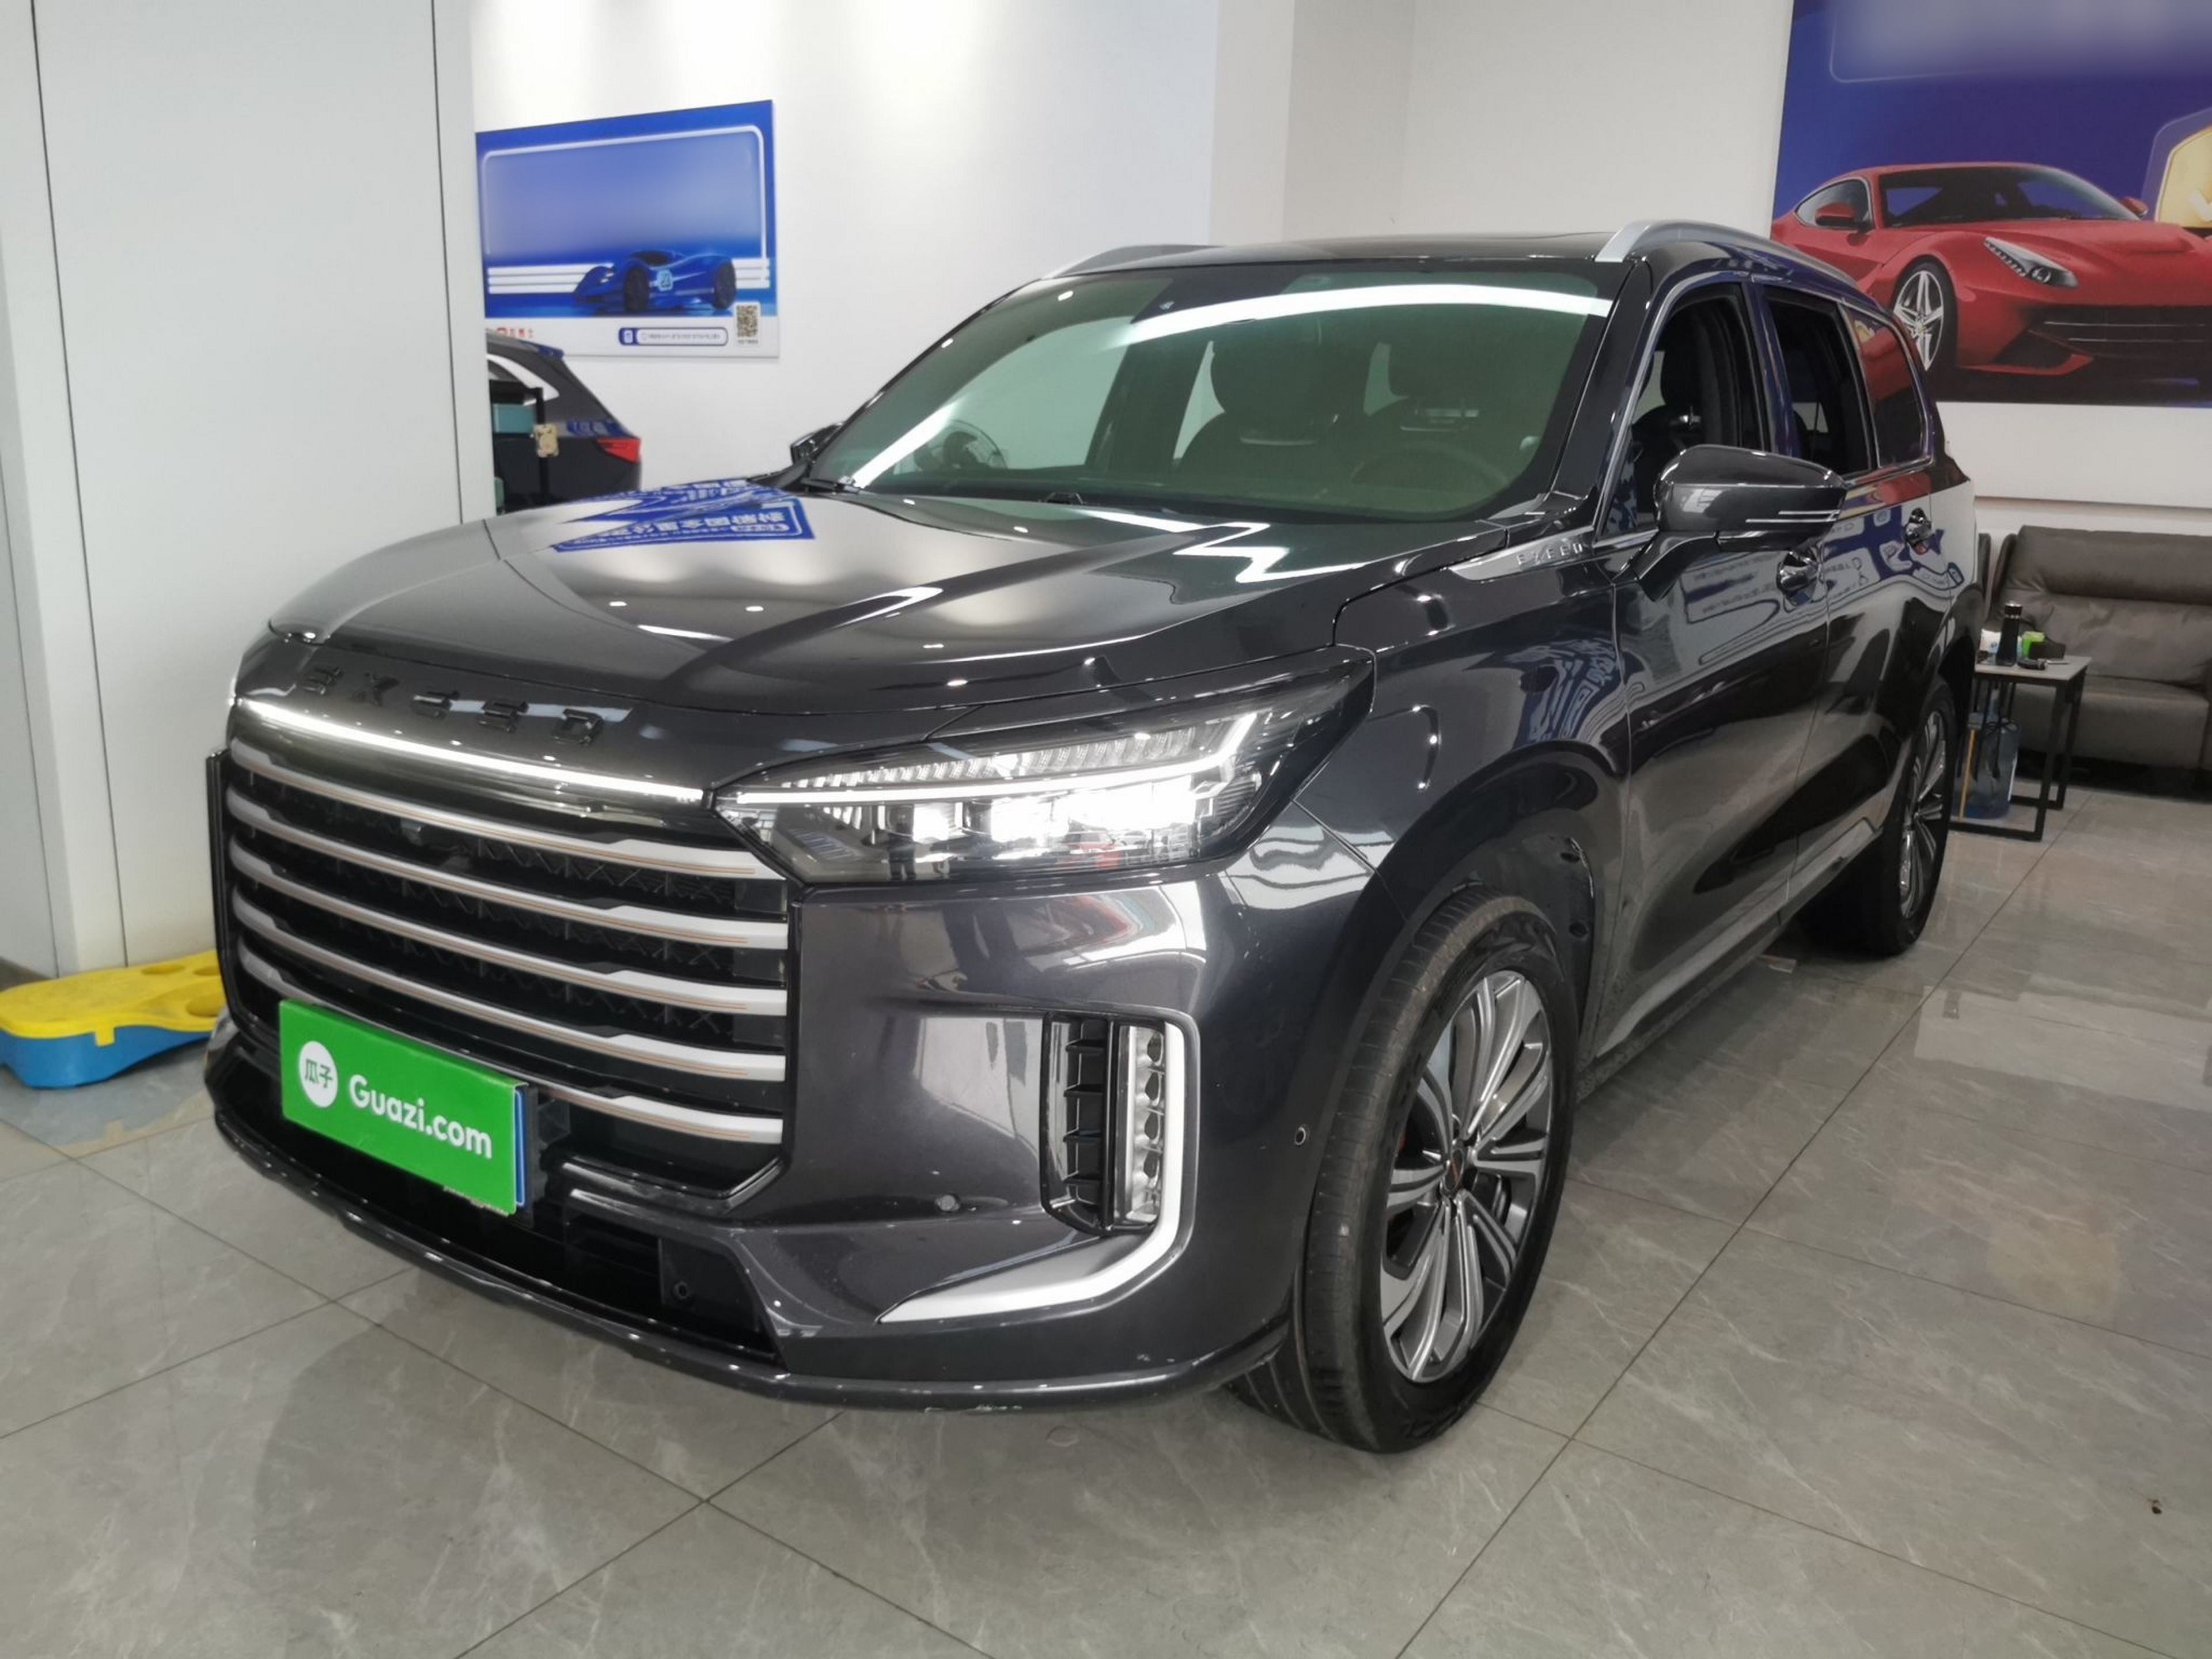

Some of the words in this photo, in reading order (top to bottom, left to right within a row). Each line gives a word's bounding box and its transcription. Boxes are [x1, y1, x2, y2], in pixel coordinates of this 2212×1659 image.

[1517, 543, 1583, 565] EXEED
[305, 1059, 333, 1089] 瓜子
[349, 1074, 493, 1159] Guazi.com
